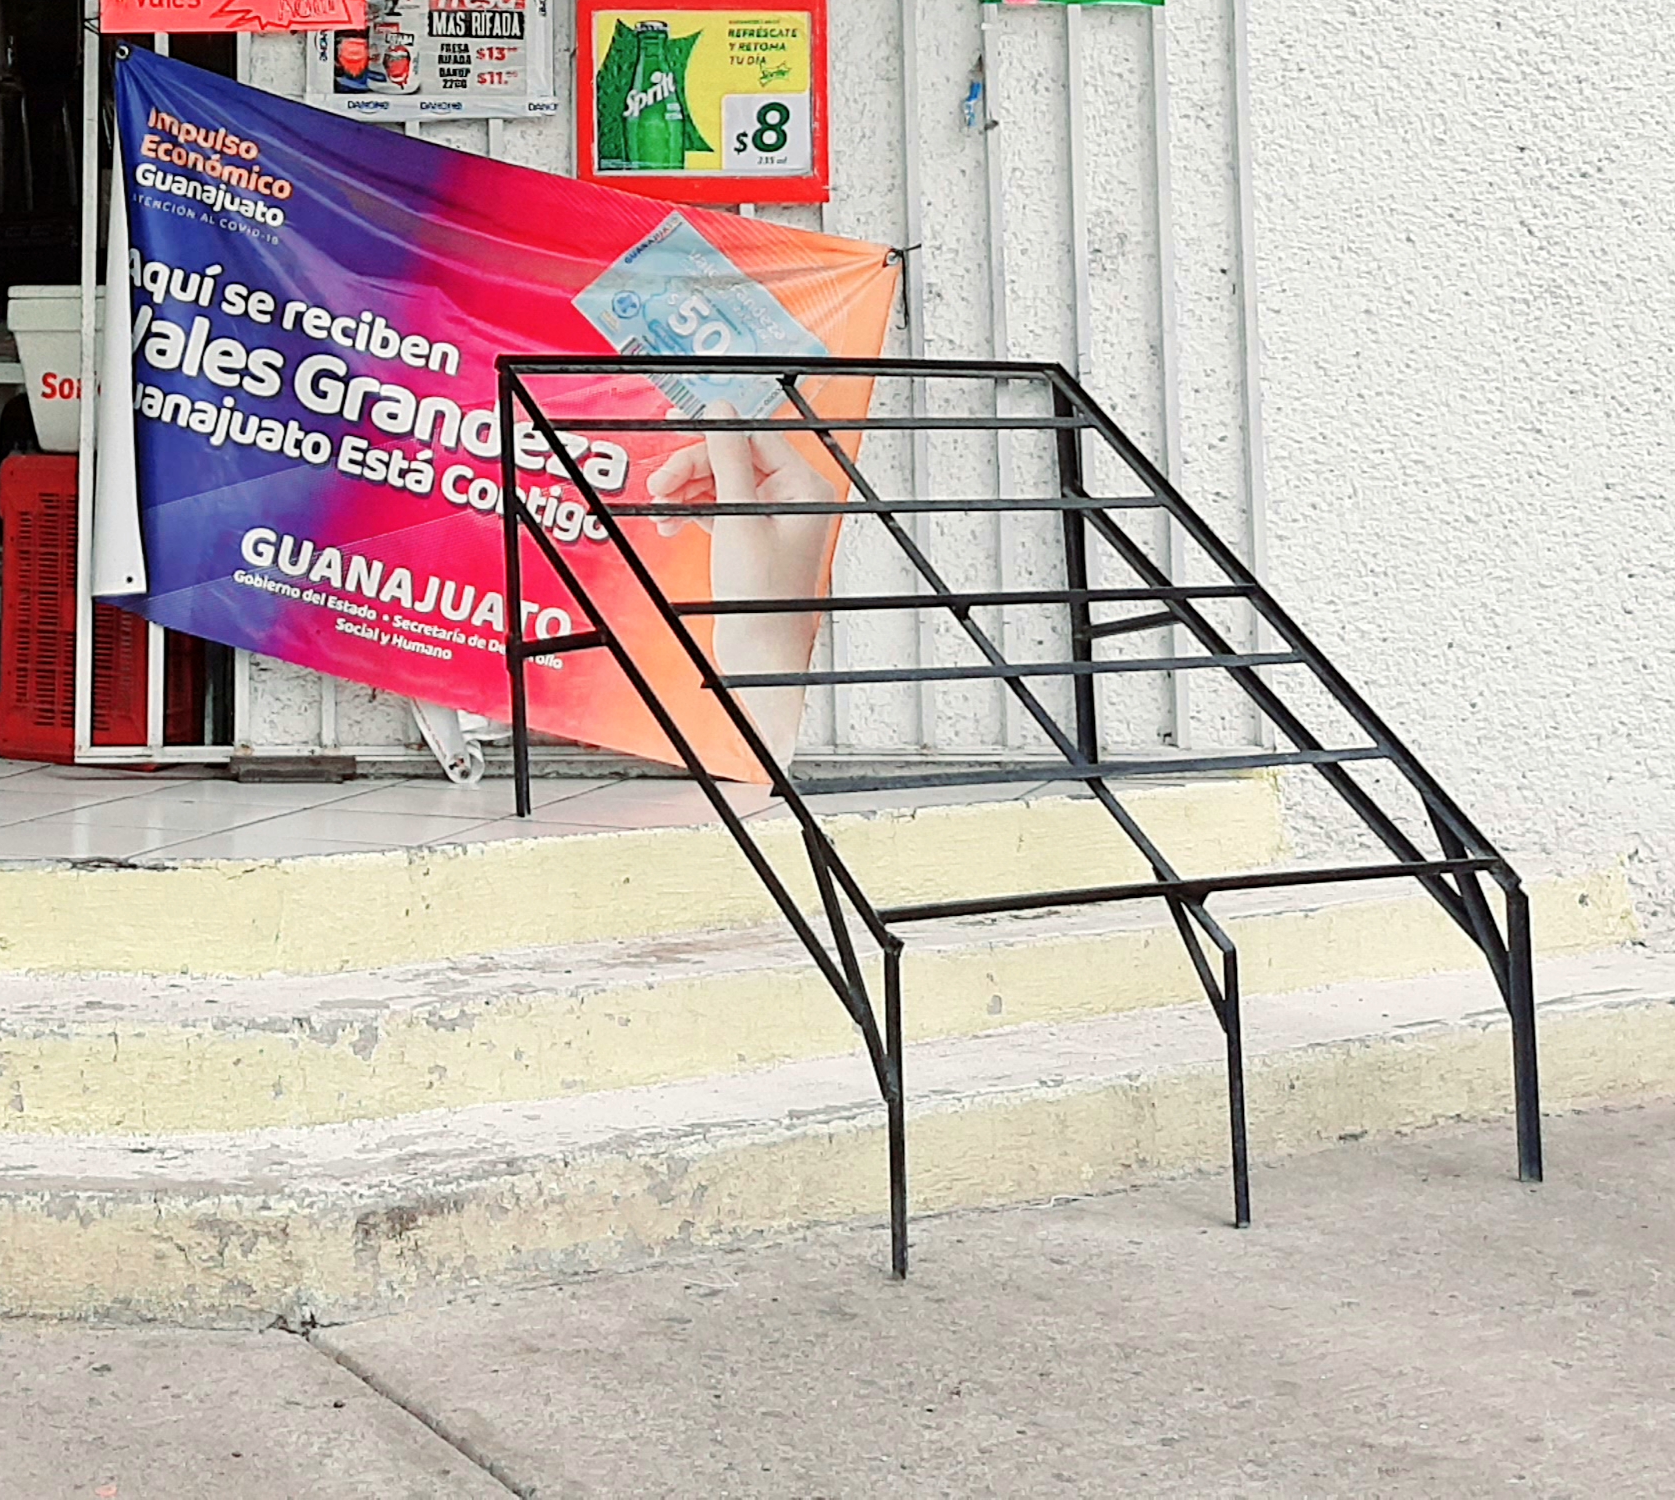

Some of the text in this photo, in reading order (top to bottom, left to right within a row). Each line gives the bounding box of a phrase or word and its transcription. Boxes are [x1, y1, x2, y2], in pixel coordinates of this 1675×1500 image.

[472, 12, 521, 36] RIFADA
[730, 56, 745, 65] TU
[147, 107, 260, 160] Impulso
[140, 134, 293, 199] Económico
[135, 163, 285, 227] Guanajuato
[200, 213, 215, 225] AL
[222, 283, 274, 324] se
[282, 300, 460, 377] reciben
[338, 435, 435, 495] Está
[233, 569, 300, 600] Gobierno
[302, 588, 326, 606] del
[327, 594, 377, 620] Estado
[467, 628, 486, 648] de
[335, 617, 453, 660] Social y Humano
